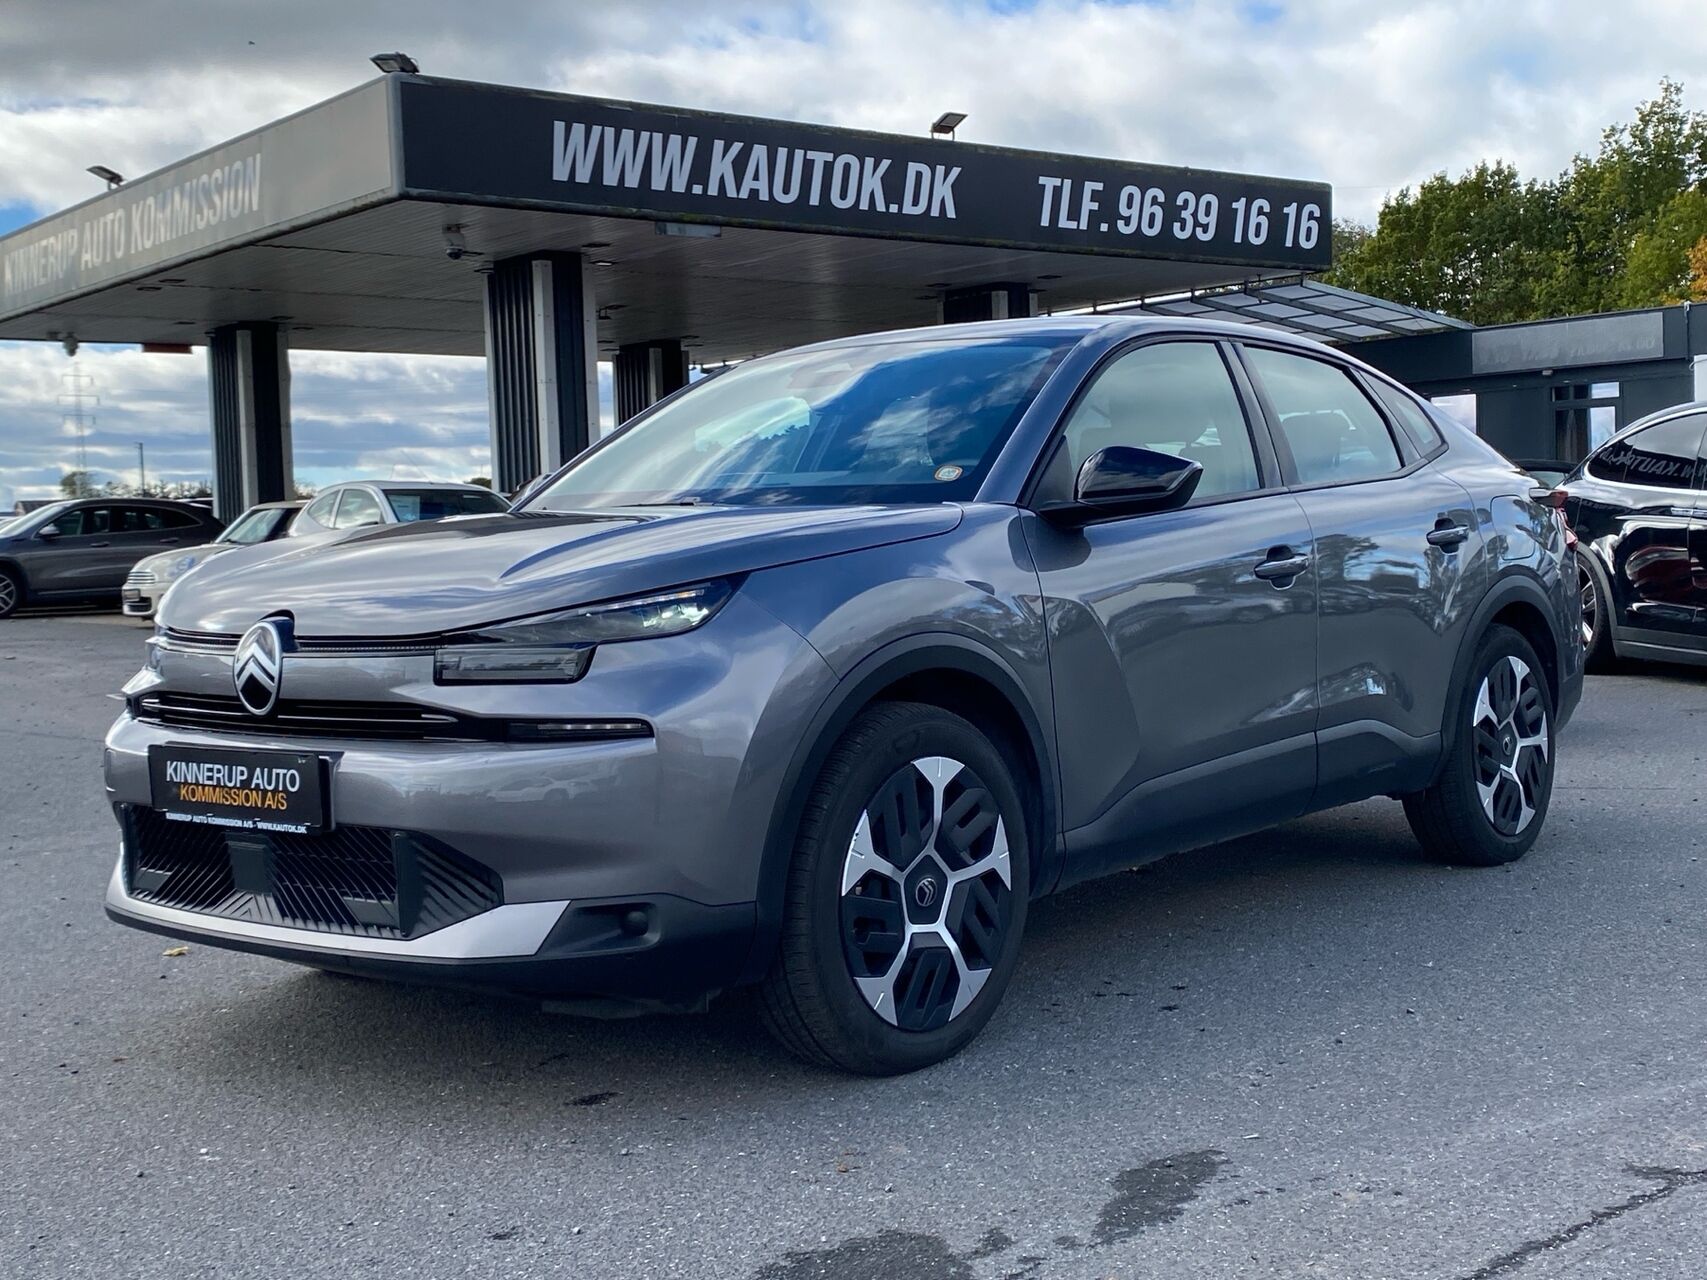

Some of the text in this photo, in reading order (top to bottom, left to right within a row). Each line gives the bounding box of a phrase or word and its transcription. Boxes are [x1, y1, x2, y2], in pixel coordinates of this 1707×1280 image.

[552, 120, 962, 219] WWW.KAUTOK.DK
[4, 153, 261, 297] KINNERUP AUTO KOMMISSION
[1038, 176, 1321, 250] TLF. 96 39 16 16
[166, 760, 300, 793] KINNERUP AUTO
[264, 793, 288, 811] A/S
